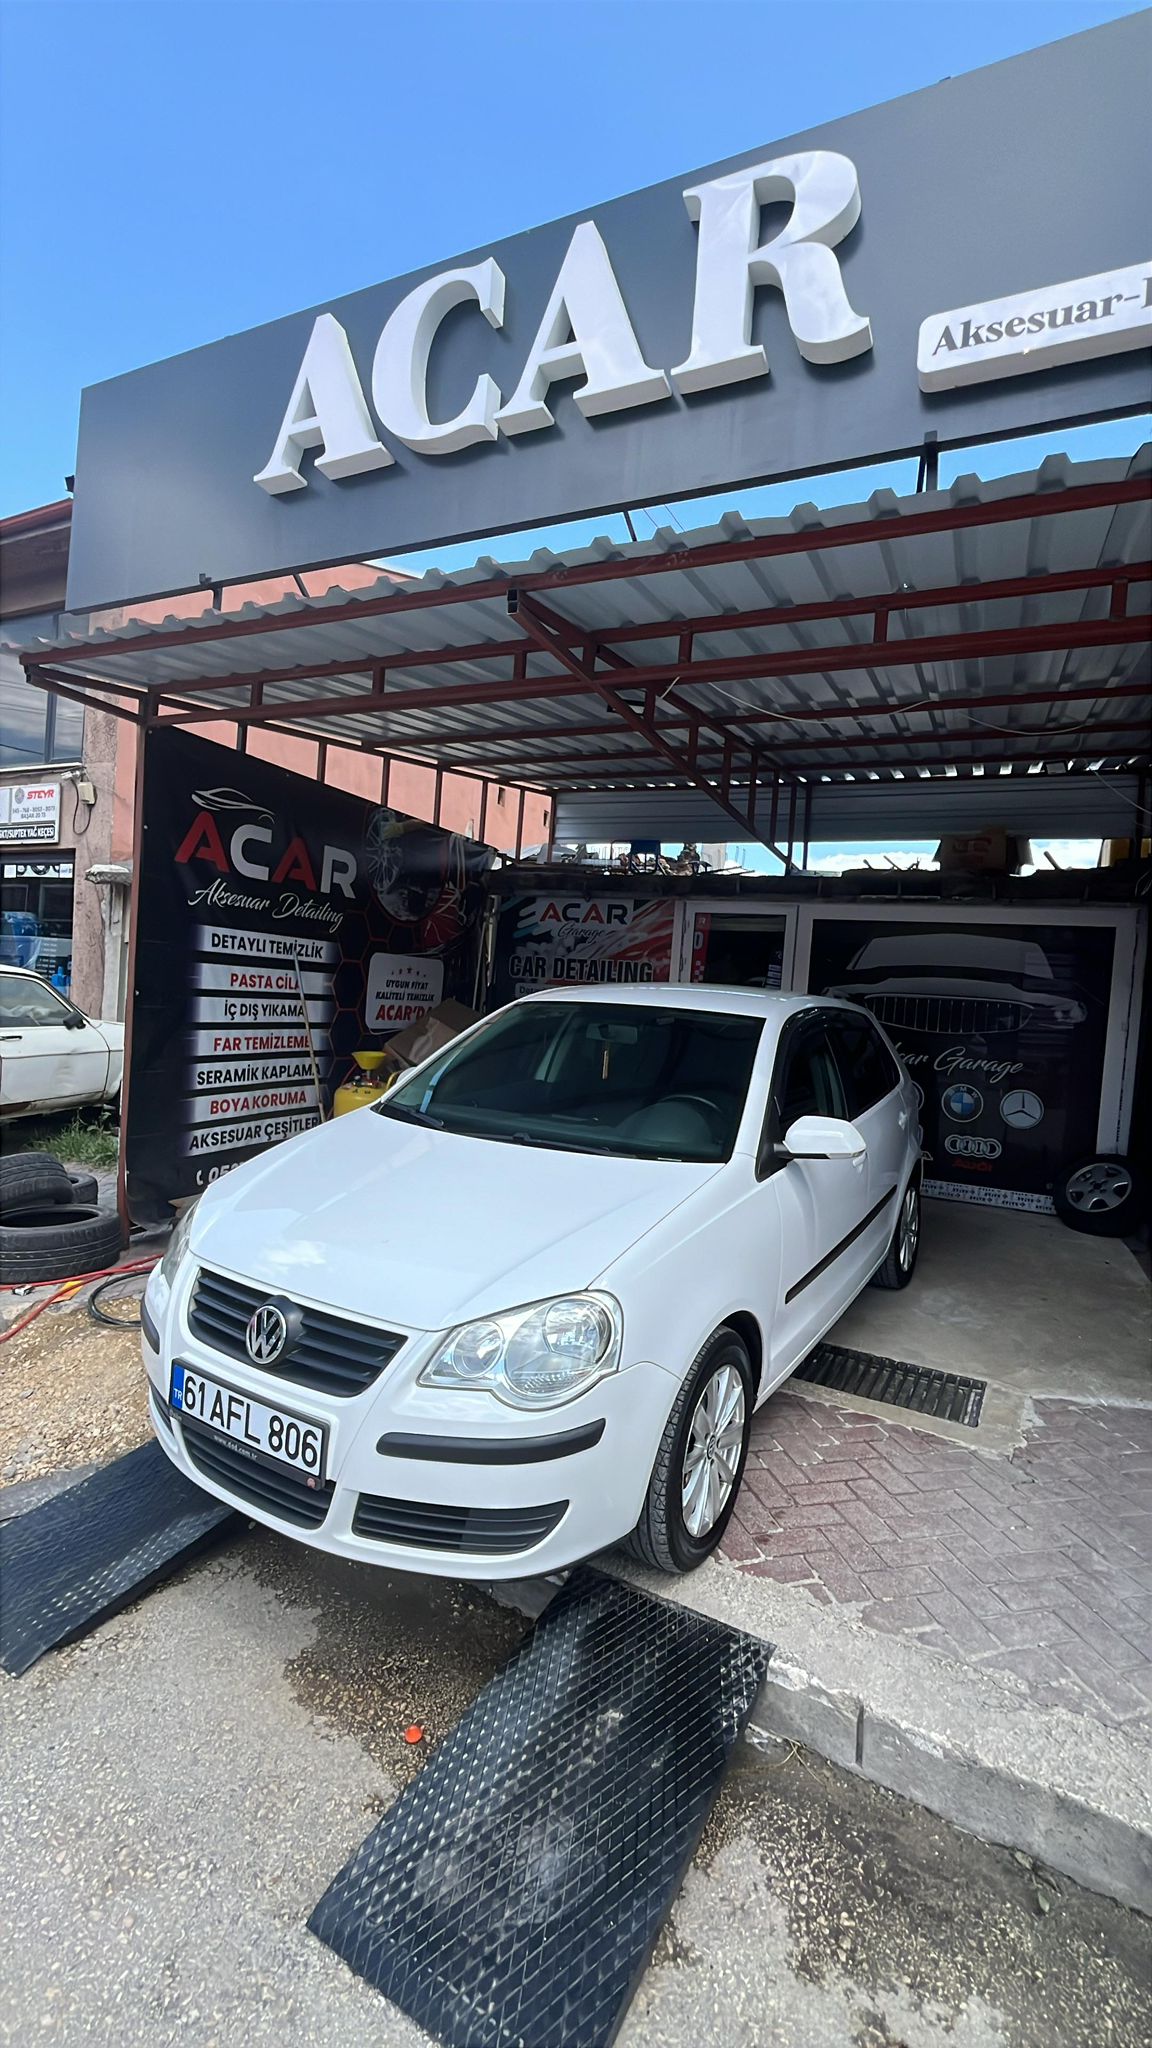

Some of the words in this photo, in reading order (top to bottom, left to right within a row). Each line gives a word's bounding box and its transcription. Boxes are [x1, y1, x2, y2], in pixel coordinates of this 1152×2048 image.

[254, 149, 873, 496] ACAR
[27, 790, 54, 800] STEYR
[174, 810, 357, 899] ACAR
[187, 878, 271, 911] Aksesuar
[271, 892, 345, 934] Detailing
[539, 902, 629, 926] ACAR
[557, 921, 616, 943] Garage
[211, 932, 266, 953] DETAYLI
[268, 939, 324, 960] TEMİZLİK
[509, 954, 546, 979] CAR
[553, 957, 655, 983] DETAILING
[230, 972, 273, 990] PASTA
[385, 979, 410, 990] UYGUN
[224, 999, 237, 1021] İÇ
[239, 1003, 259, 1021] DIŞ
[261, 1003, 305, 1018] YIKAMA
[213, 1037, 242, 1052] FAR
[197, 1064, 260, 1086] SERAMİK
[932, 1045, 1025, 1084] Garage
[210, 1097, 250, 1115] BOYA
[252, 1090, 307, 1110] KORUMA
[189, 1125, 262, 1151] AKSESUAR
[173, 1387, 183, 1400] TR
[183, 1375, 206, 1417] 61
[209, 1389, 261, 1445] AFL
[267, 1414, 319, 1469] 806
